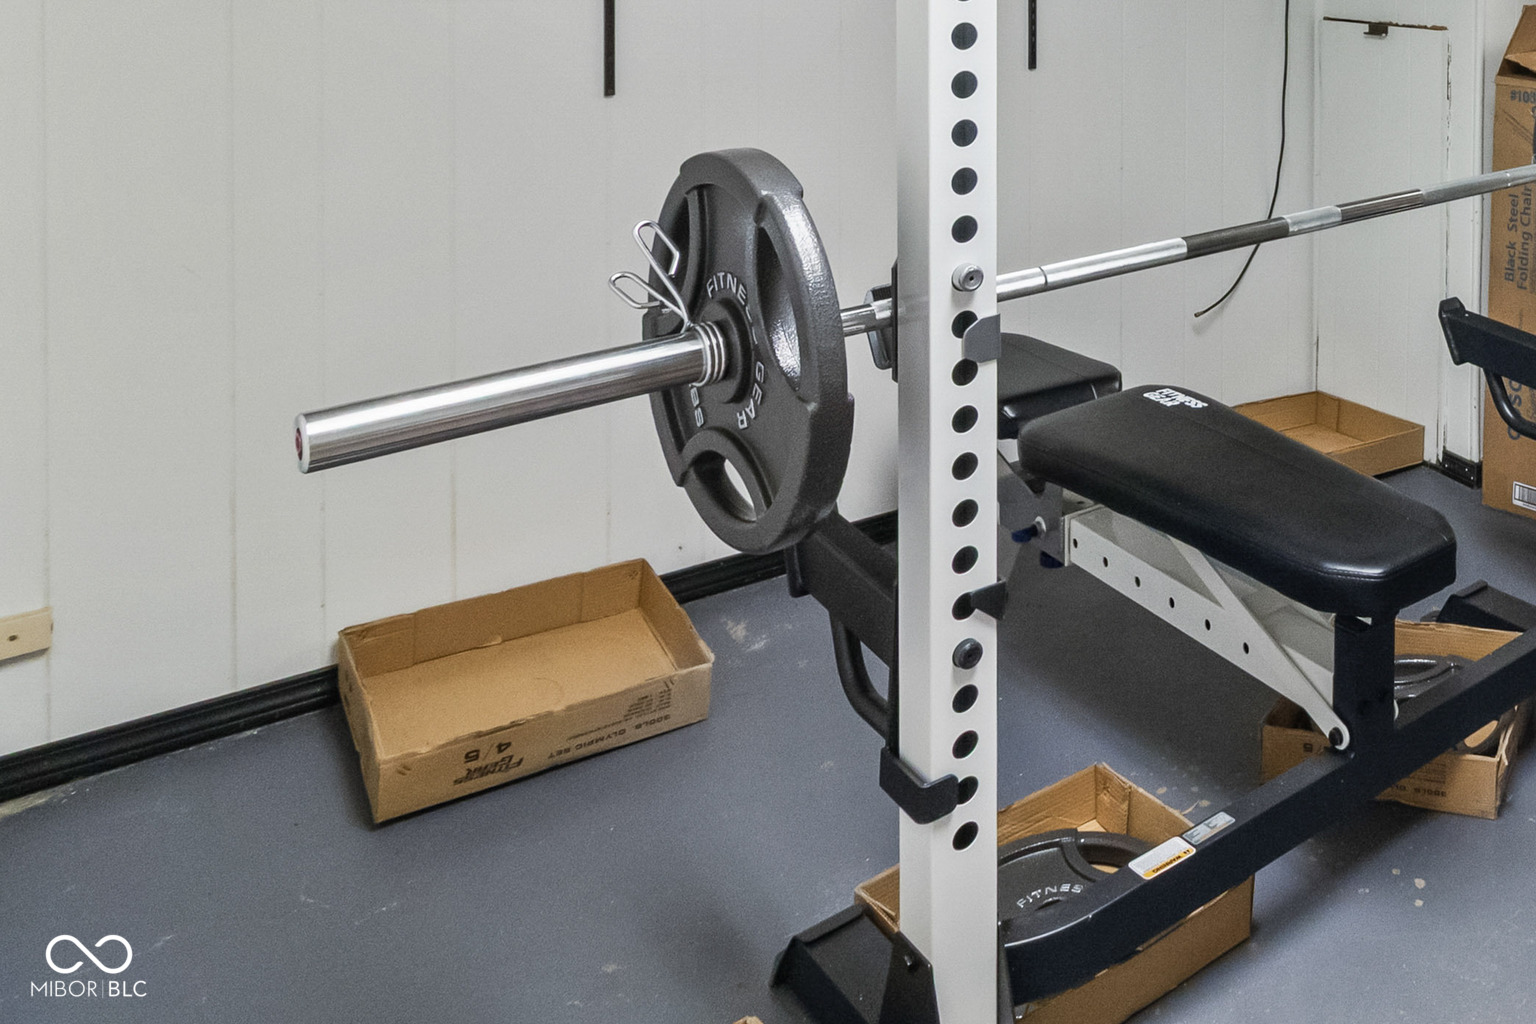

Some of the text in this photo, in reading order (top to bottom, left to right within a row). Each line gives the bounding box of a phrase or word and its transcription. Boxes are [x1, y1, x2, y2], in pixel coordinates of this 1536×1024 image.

[1504, 193, 1520, 283] Black Steel
[1517, 233, 1533, 290] Folding
[690, 385, 705, 427] BS
[737, 361, 764, 429] GEAR
[575, 728, 627, 750] OLYMPIC
[1016, 883, 1086, 908] FITNES
